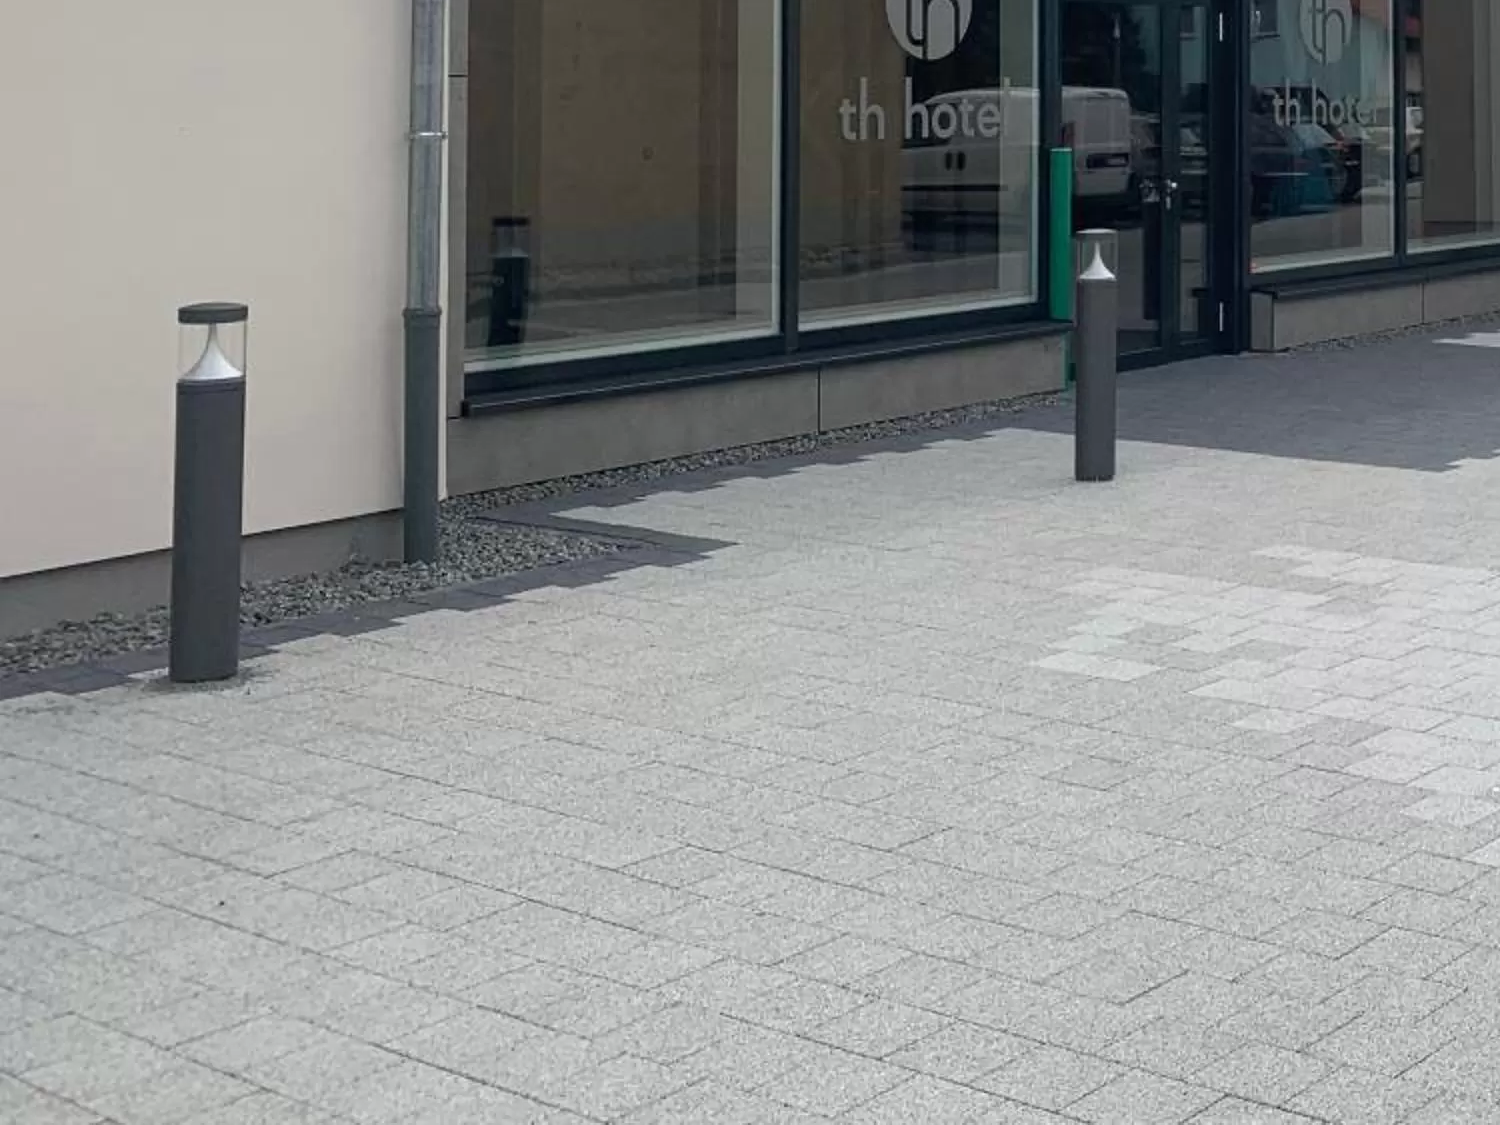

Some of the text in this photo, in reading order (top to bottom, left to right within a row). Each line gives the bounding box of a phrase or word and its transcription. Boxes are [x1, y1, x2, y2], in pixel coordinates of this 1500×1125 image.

[840, 77, 1010, 140] th hotel
[1272, 78, 1300, 126] th
